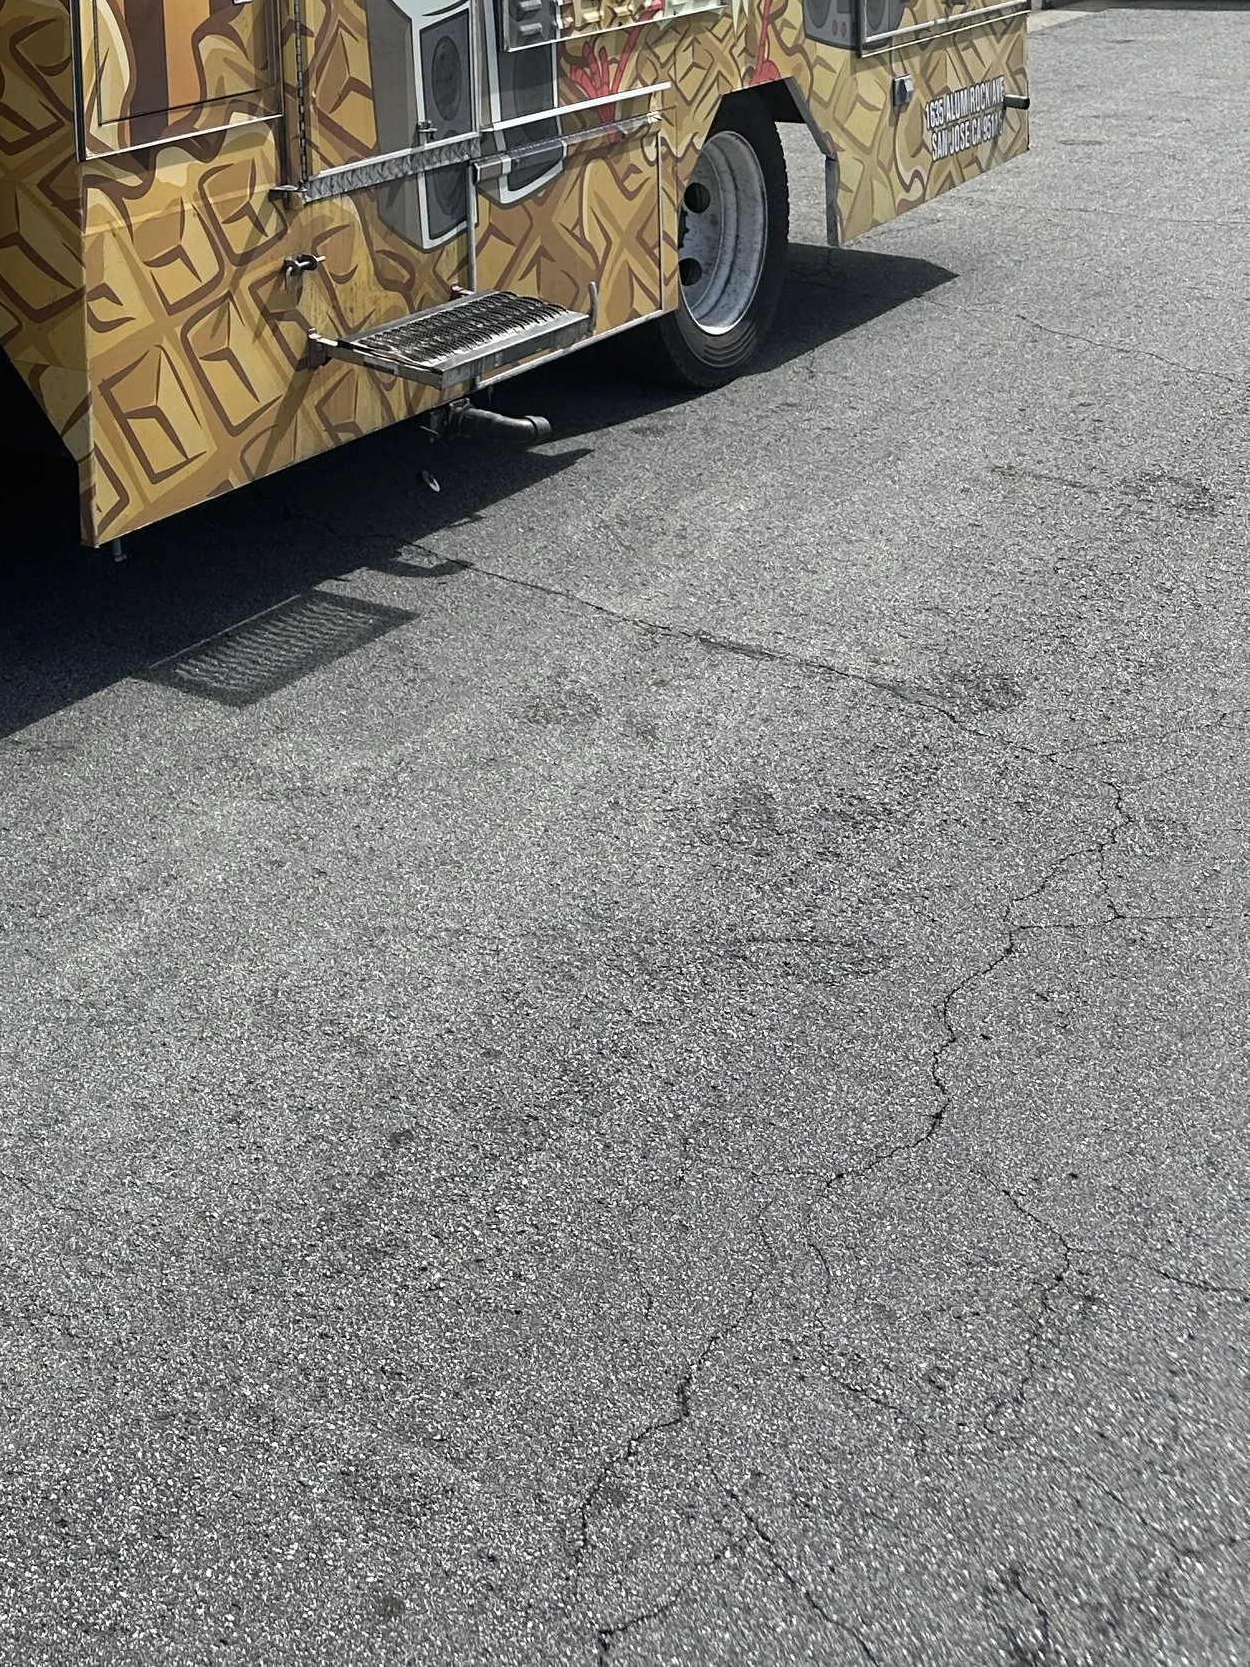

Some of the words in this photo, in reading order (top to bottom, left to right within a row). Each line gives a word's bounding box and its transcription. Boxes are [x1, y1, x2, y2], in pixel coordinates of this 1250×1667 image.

[925, 99, 944, 129] 1635
[946, 89, 968, 122] ALUM
[970, 84, 991, 112] ROCK
[932, 131, 948, 161] SAN
[949, 122, 970, 154] JOSE
[971, 117, 982, 146] CA
